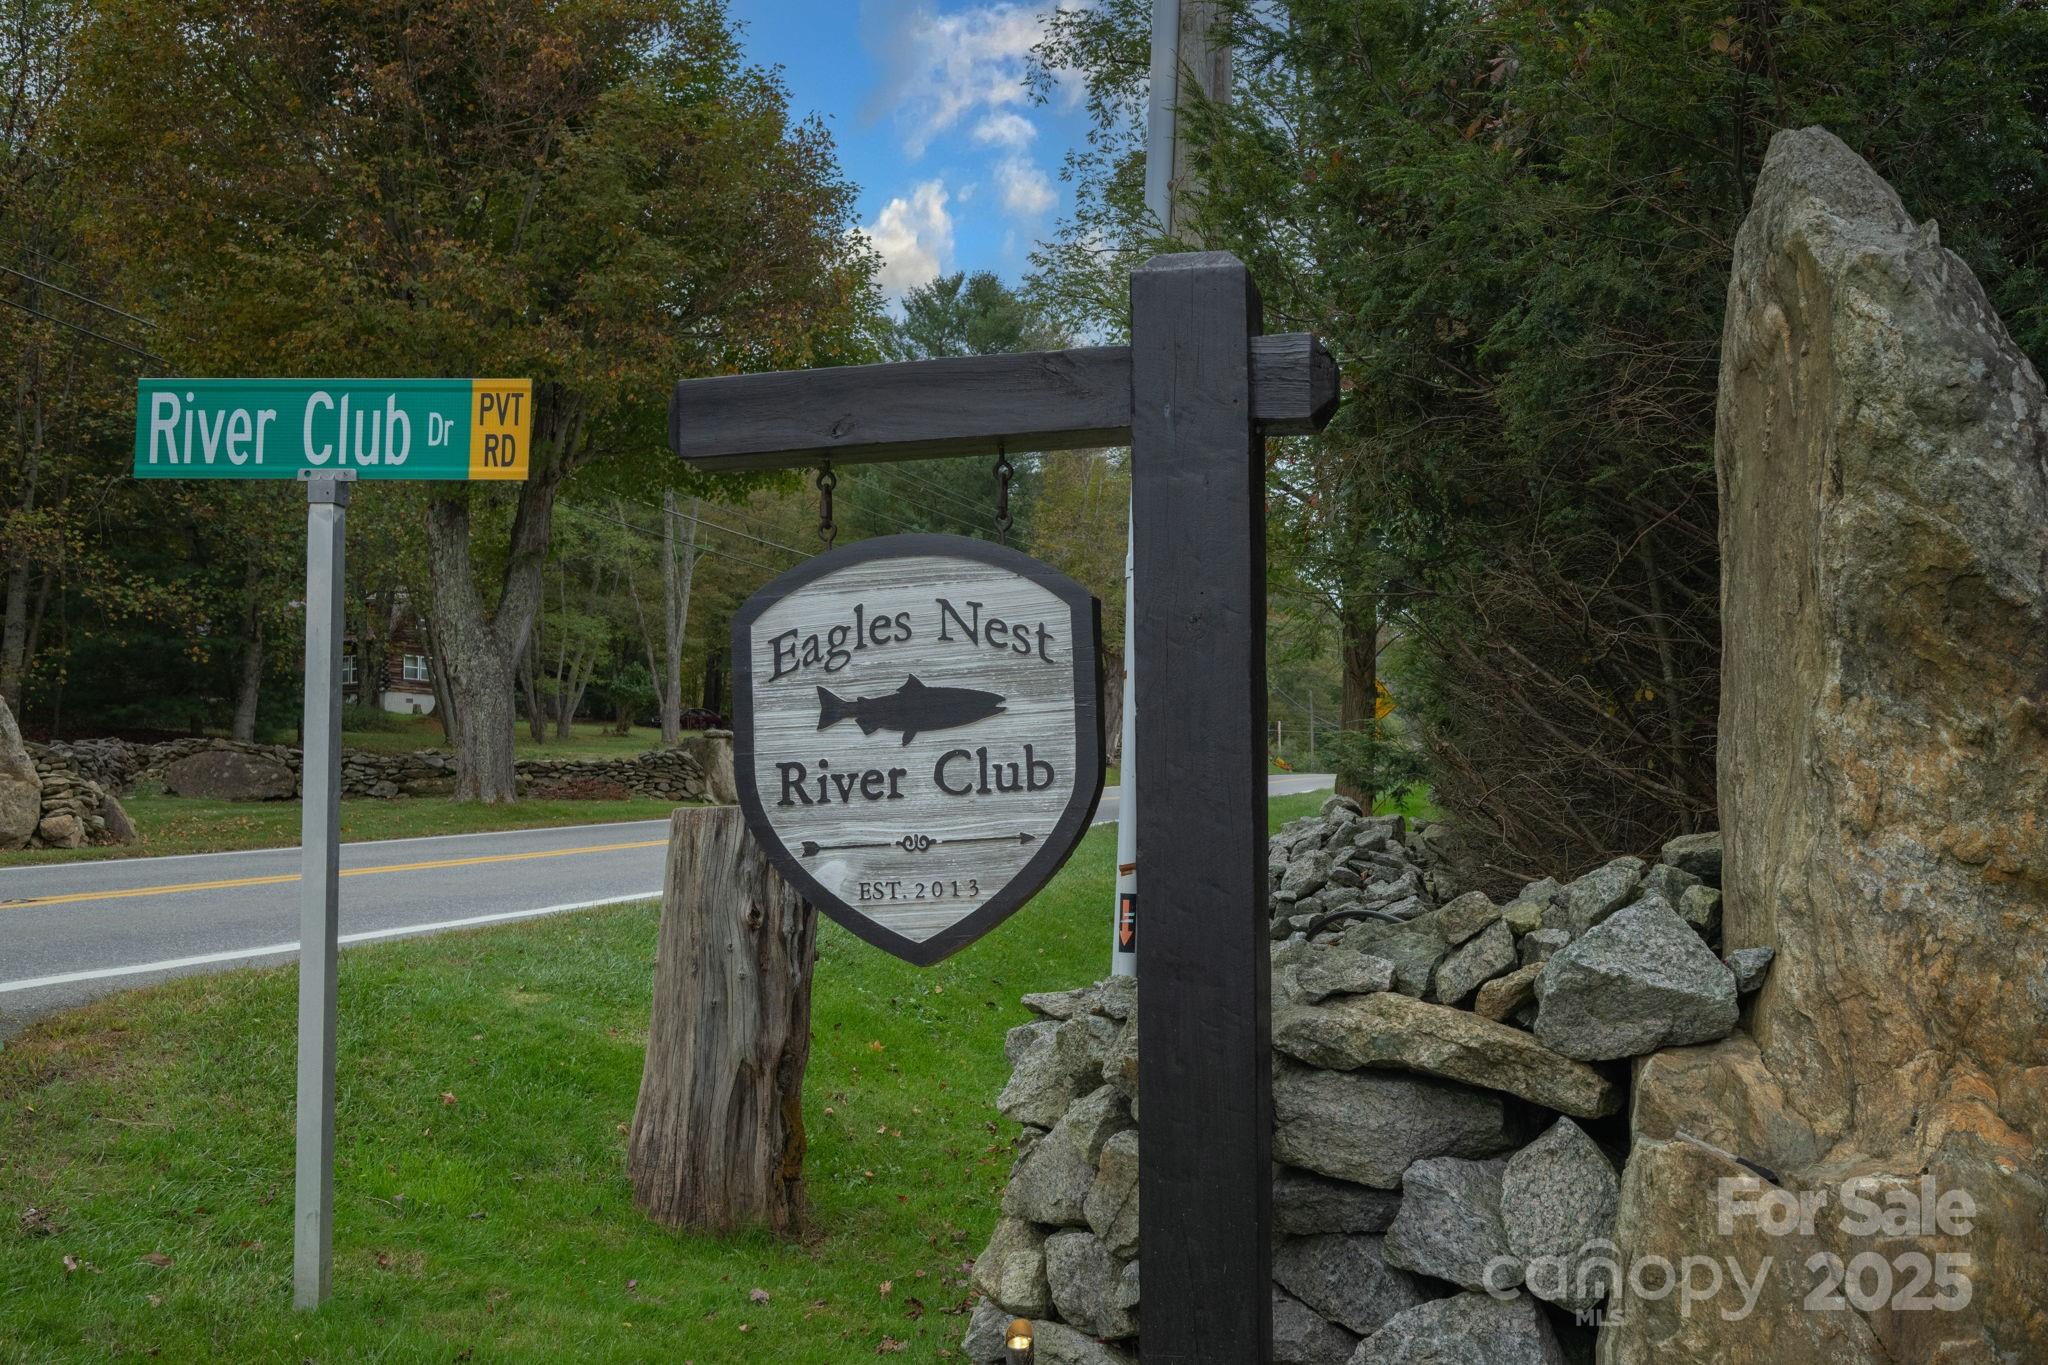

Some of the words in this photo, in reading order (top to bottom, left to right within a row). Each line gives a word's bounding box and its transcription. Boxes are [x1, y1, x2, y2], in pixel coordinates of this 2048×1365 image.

[149, 391, 277, 465] River
[303, 390, 411, 466] Club
[428, 411, 454, 447] Dr
[479, 392, 524, 426] PVT
[484, 434, 516, 468] RD
[767, 603, 913, 683] Eagles
[935, 598, 1055, 664] Nest
[775, 759, 908, 807] River
[933, 743, 1055, 797] Club
[858, 881, 907, 901] EST.
[915, 879, 980, 899] 2013
